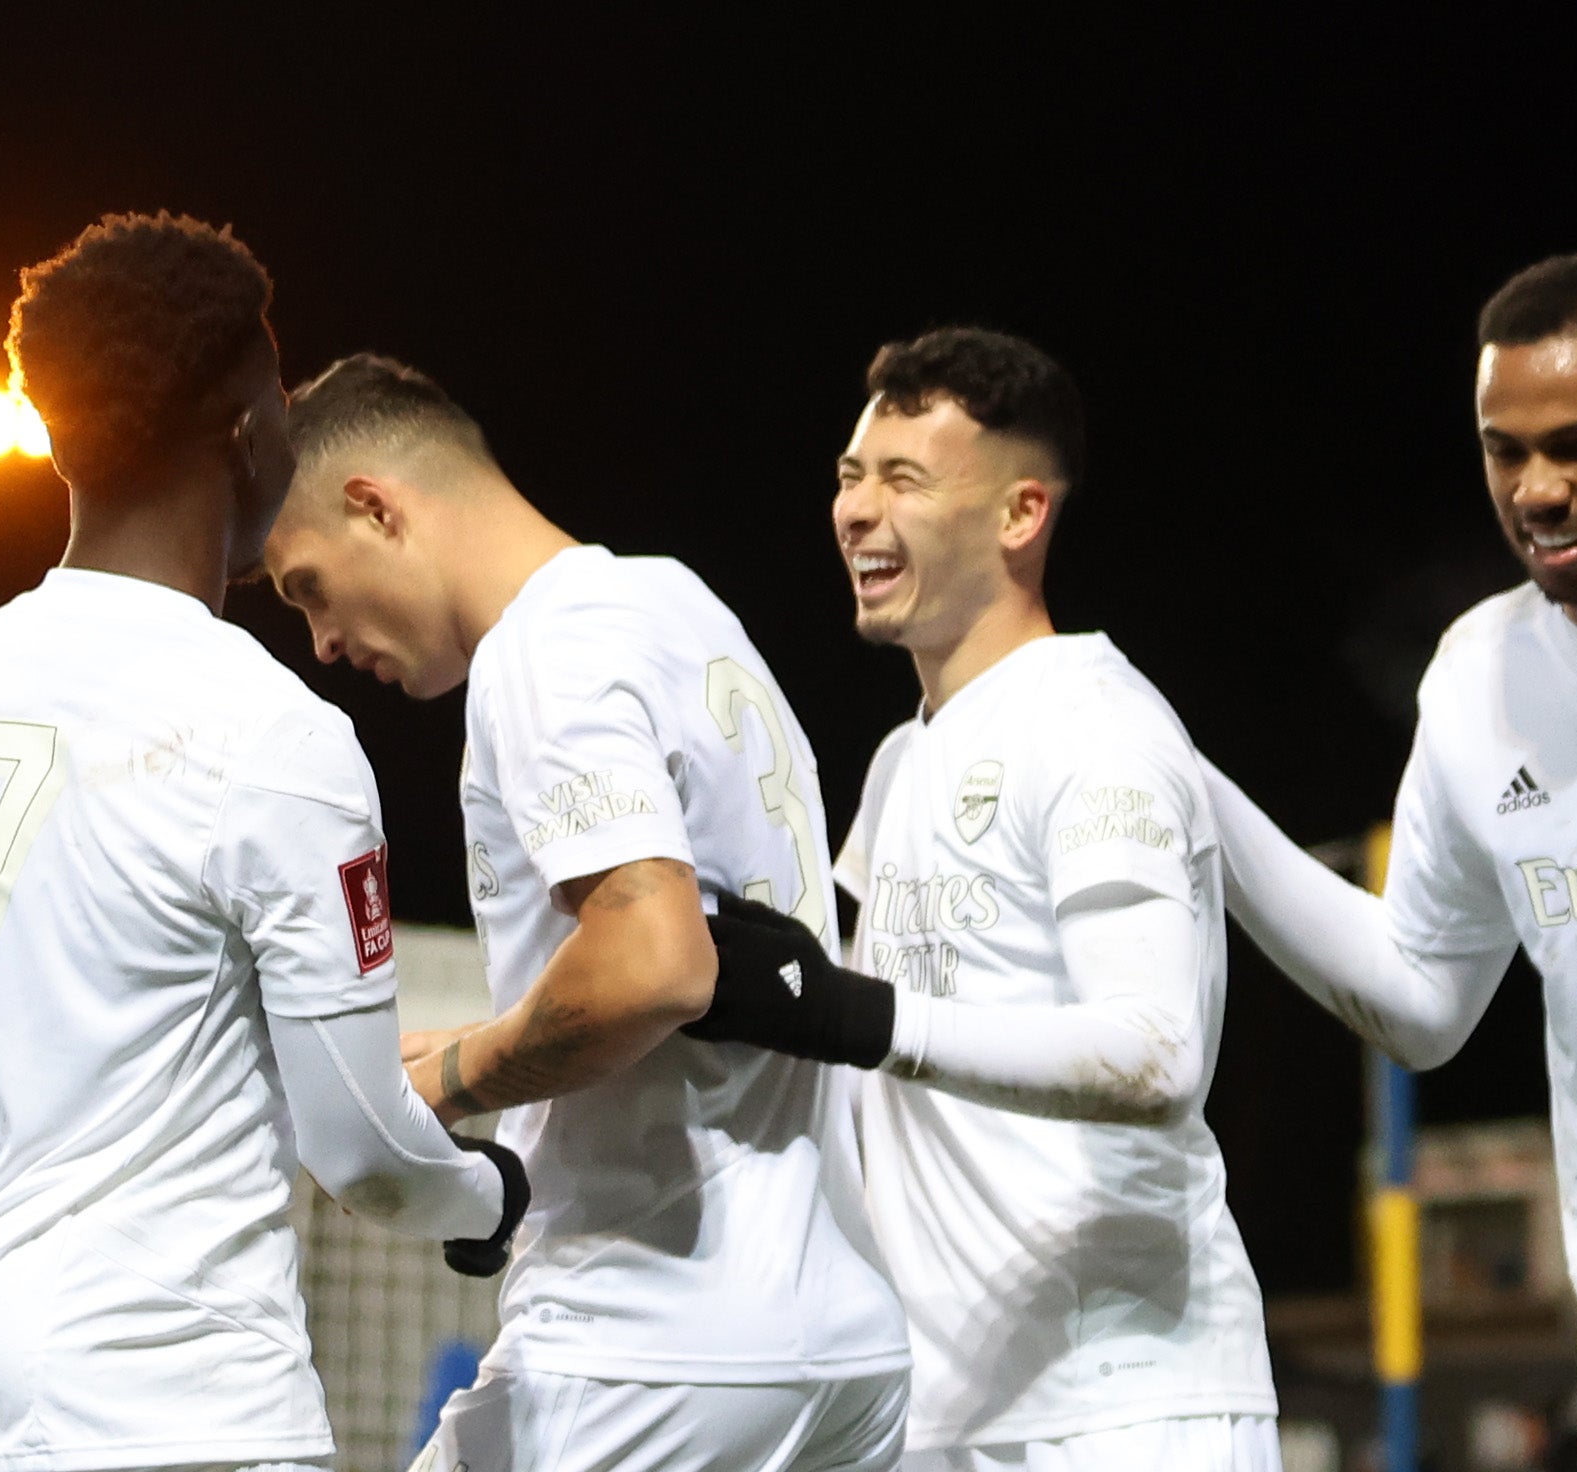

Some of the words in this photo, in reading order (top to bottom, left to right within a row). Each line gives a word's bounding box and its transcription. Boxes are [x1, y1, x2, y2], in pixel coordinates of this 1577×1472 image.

[537, 768, 615, 815] VISIT
[1080, 785, 1155, 817] VISIT
[1496, 789, 1551, 816] adidas
[522, 788, 658, 856] RWANDA
[1057, 814, 1177, 856] RWANDA
